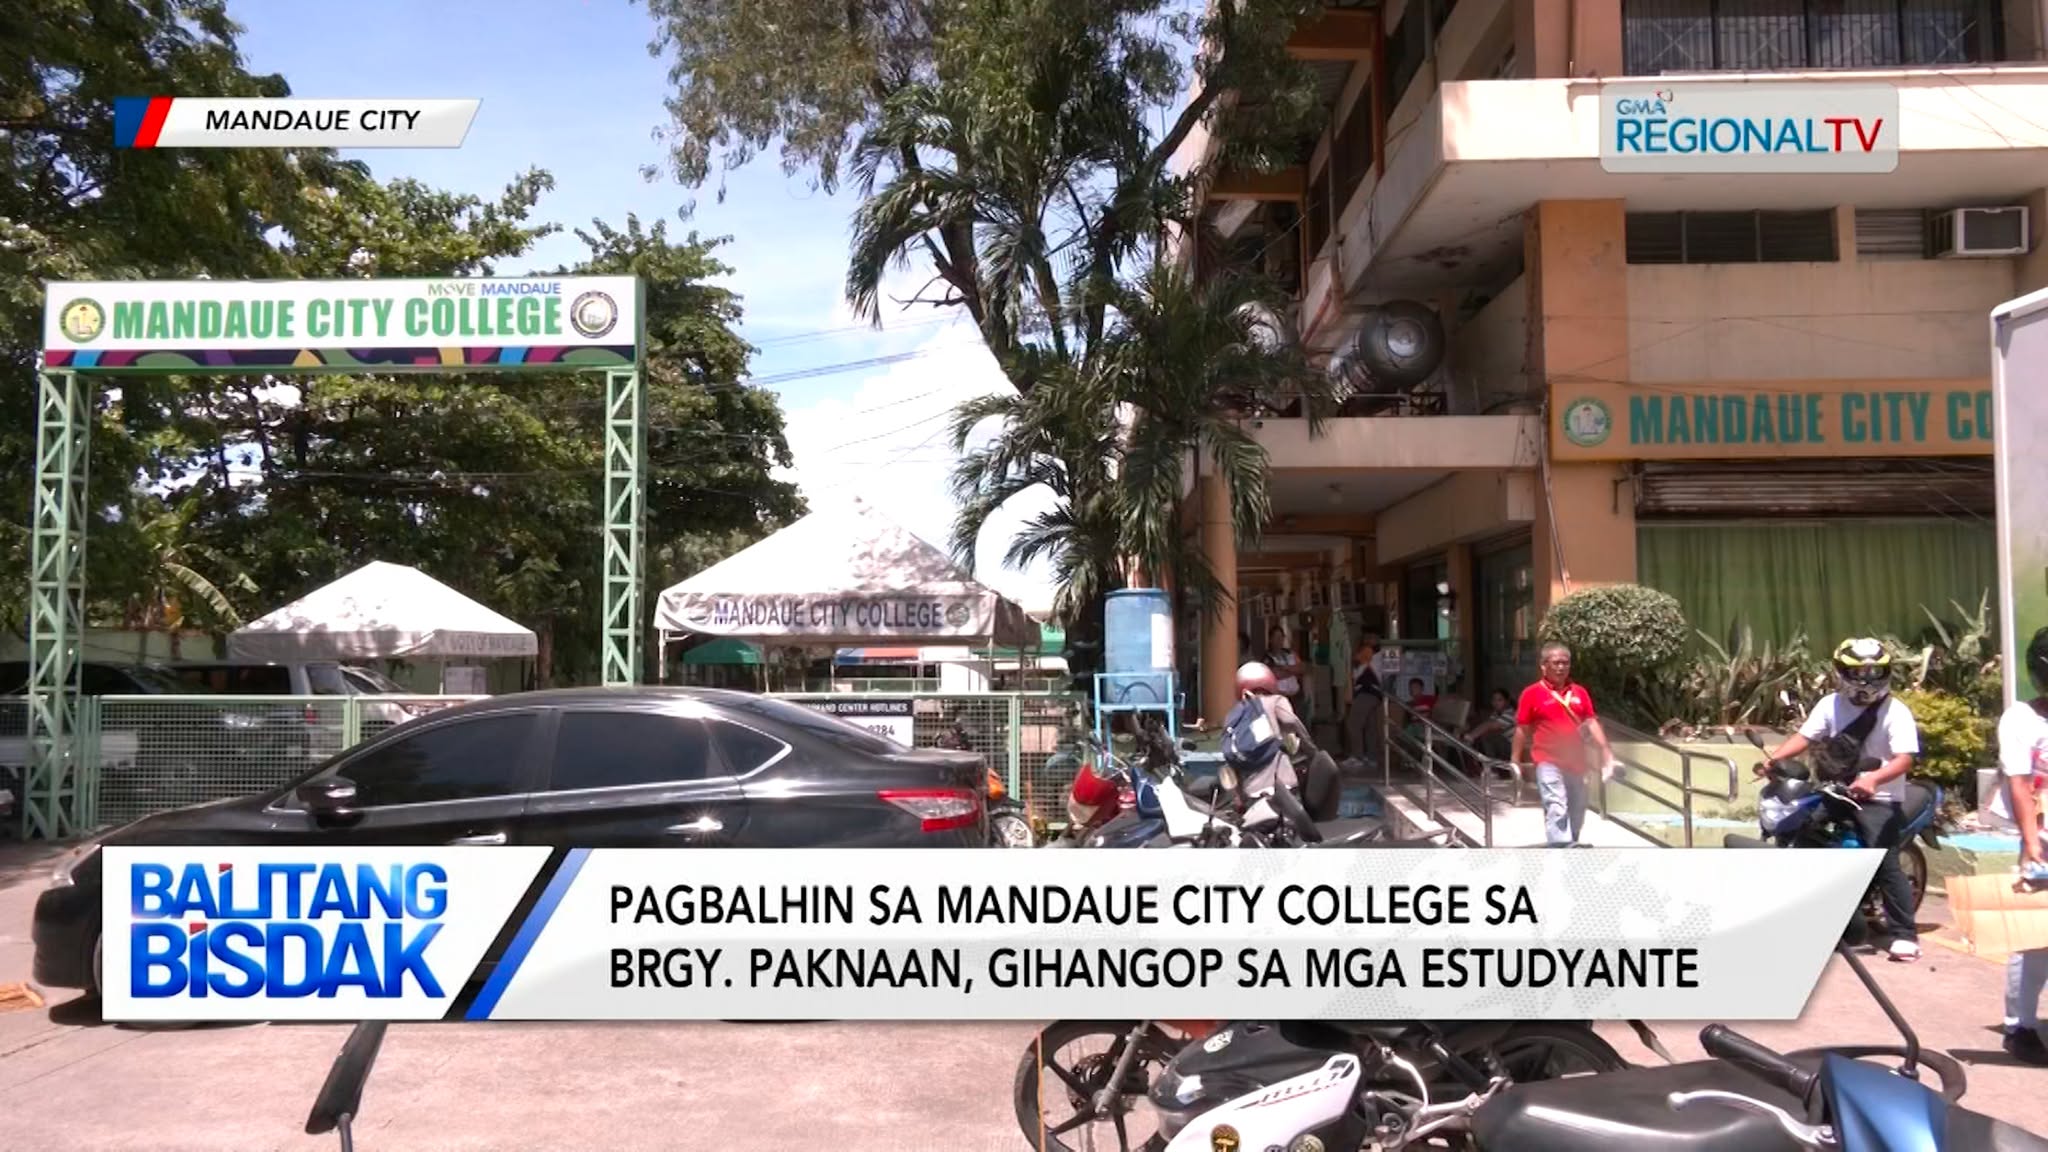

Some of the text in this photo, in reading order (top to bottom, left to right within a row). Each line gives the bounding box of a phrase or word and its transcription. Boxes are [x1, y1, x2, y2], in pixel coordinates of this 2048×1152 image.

[481, 282, 562, 295] MANDAUE
[112, 300, 295, 339] MANDAUE
[306, 298, 395, 337] CITY
[404, 297, 563, 337] COLLEGE
[1629, 394, 1826, 445] MANDAUE
[1841, 391, 1931, 442] CITY
[714, 600, 805, 626] MANDAUE
[810, 601, 852, 627] CITY
[855, 601, 944, 628] COLLEGE
[838, 703, 868, 713] CENTER
[869, 703, 908, 713] HOTLINES
